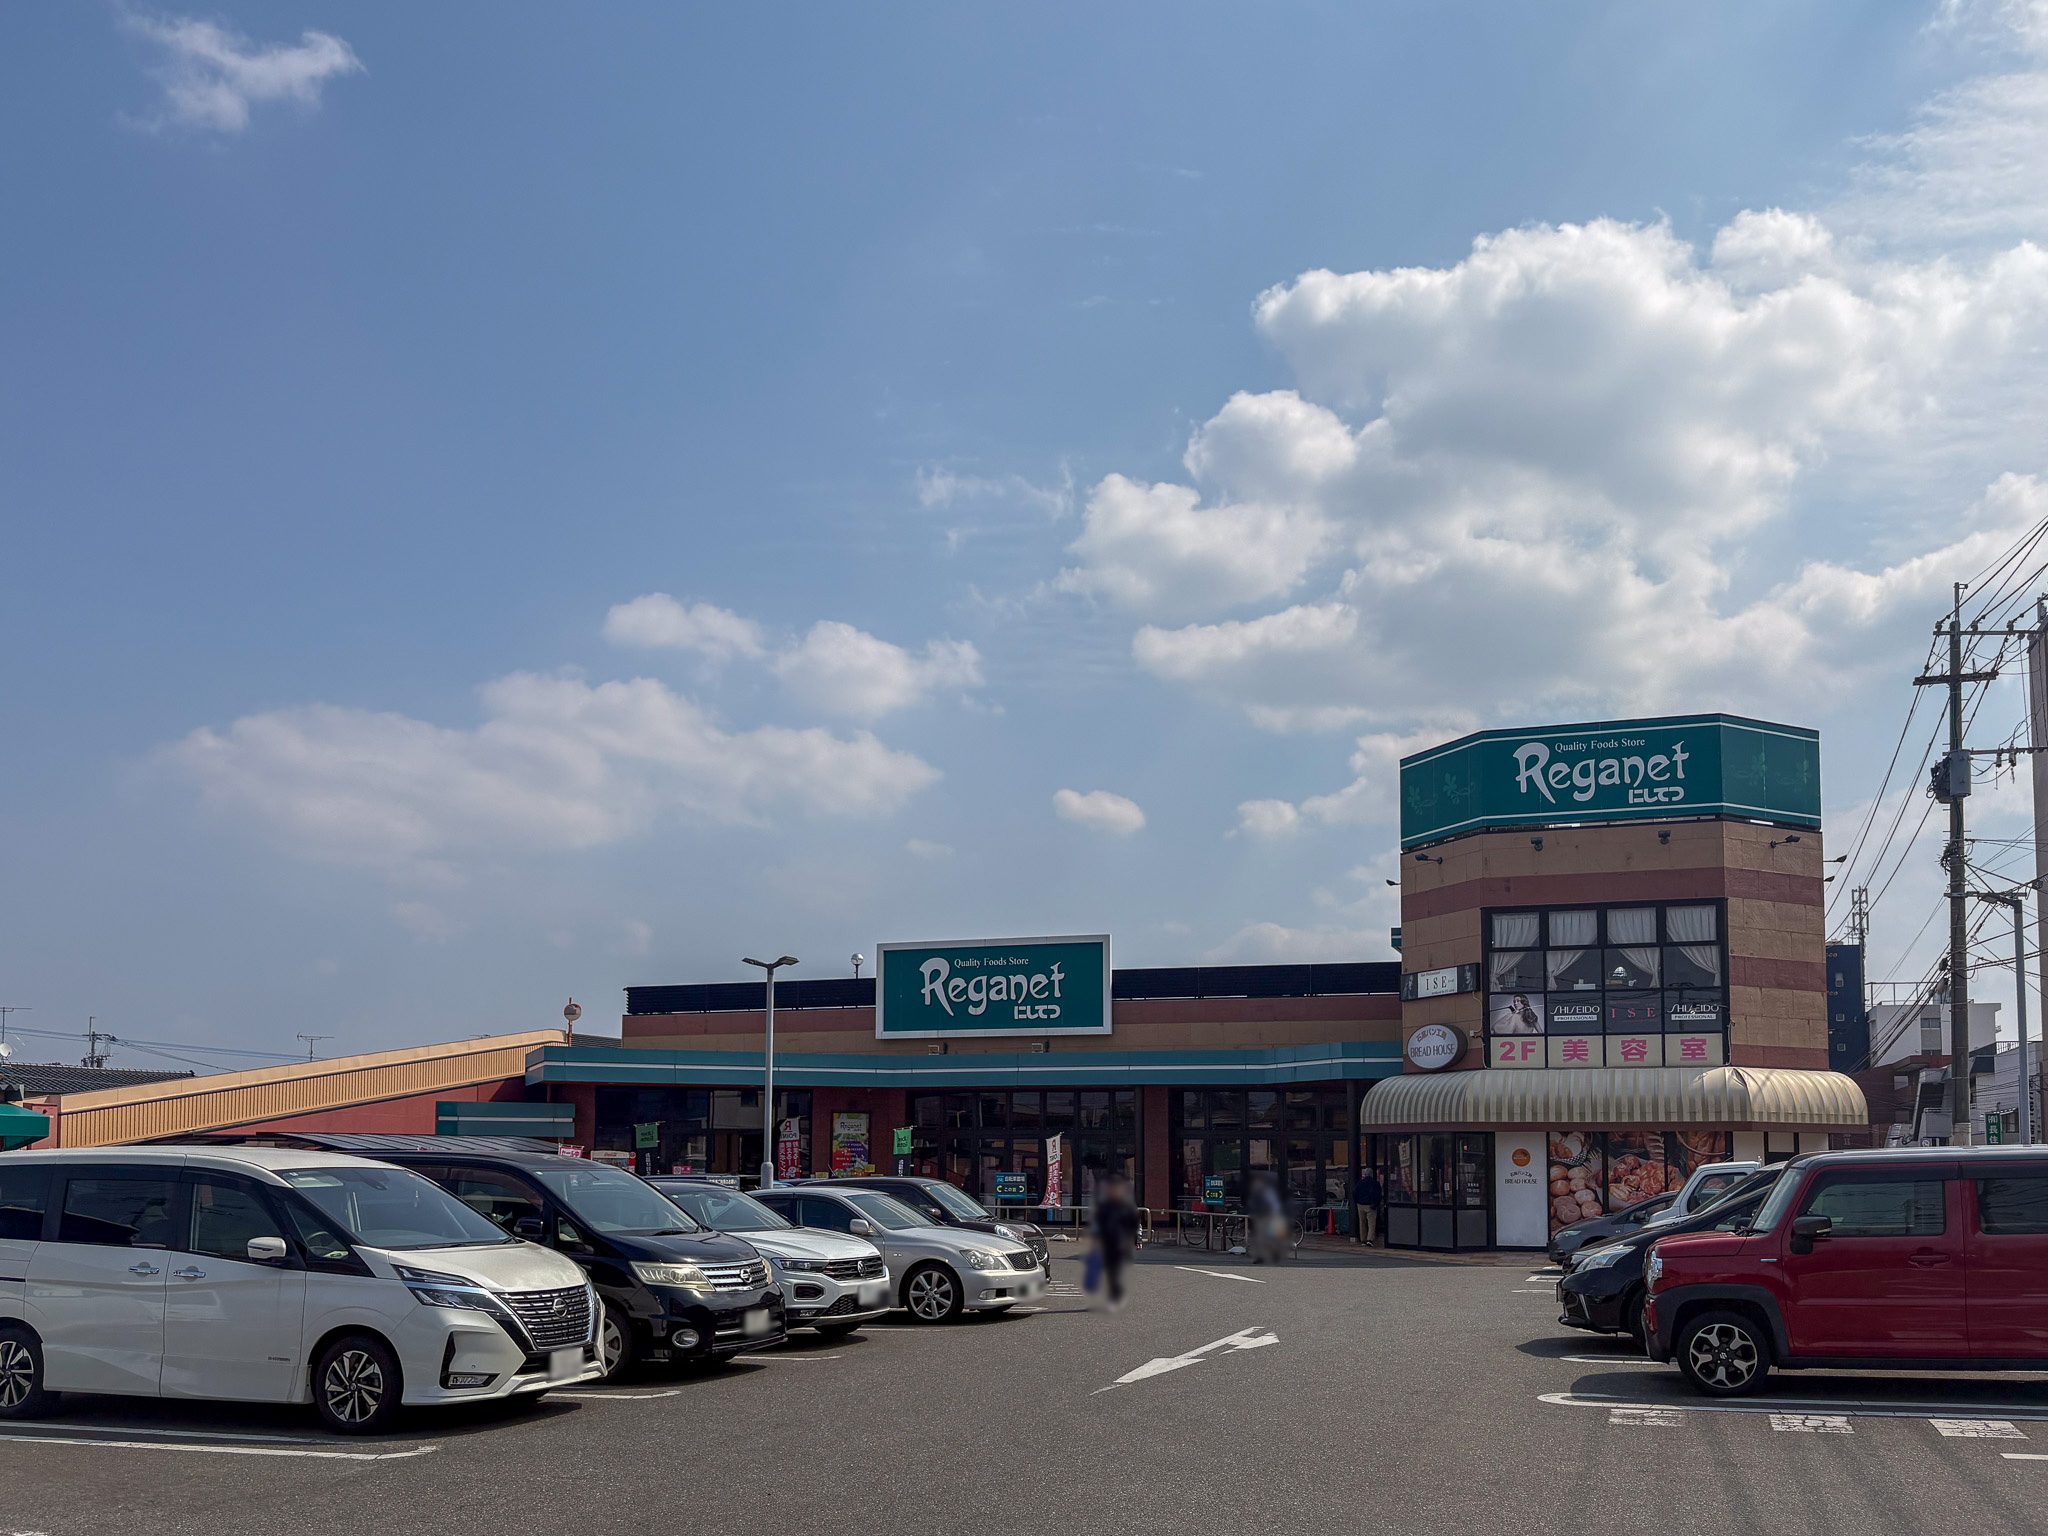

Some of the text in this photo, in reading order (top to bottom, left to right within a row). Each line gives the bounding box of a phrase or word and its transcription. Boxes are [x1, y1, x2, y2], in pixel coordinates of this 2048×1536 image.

[1555, 737, 1646, 753] Quality Foods Store
[1513, 740, 1690, 804] Reganet
[954, 956, 1029, 968] Quality Foods Store
[919, 957, 1066, 1016] Reganet
[1550, 1005, 1600, 1015] SHISEIDO
[1410, 1044, 1455, 1058] BREAD HOUSE
[1499, 1040, 1537, 1061] 2F
